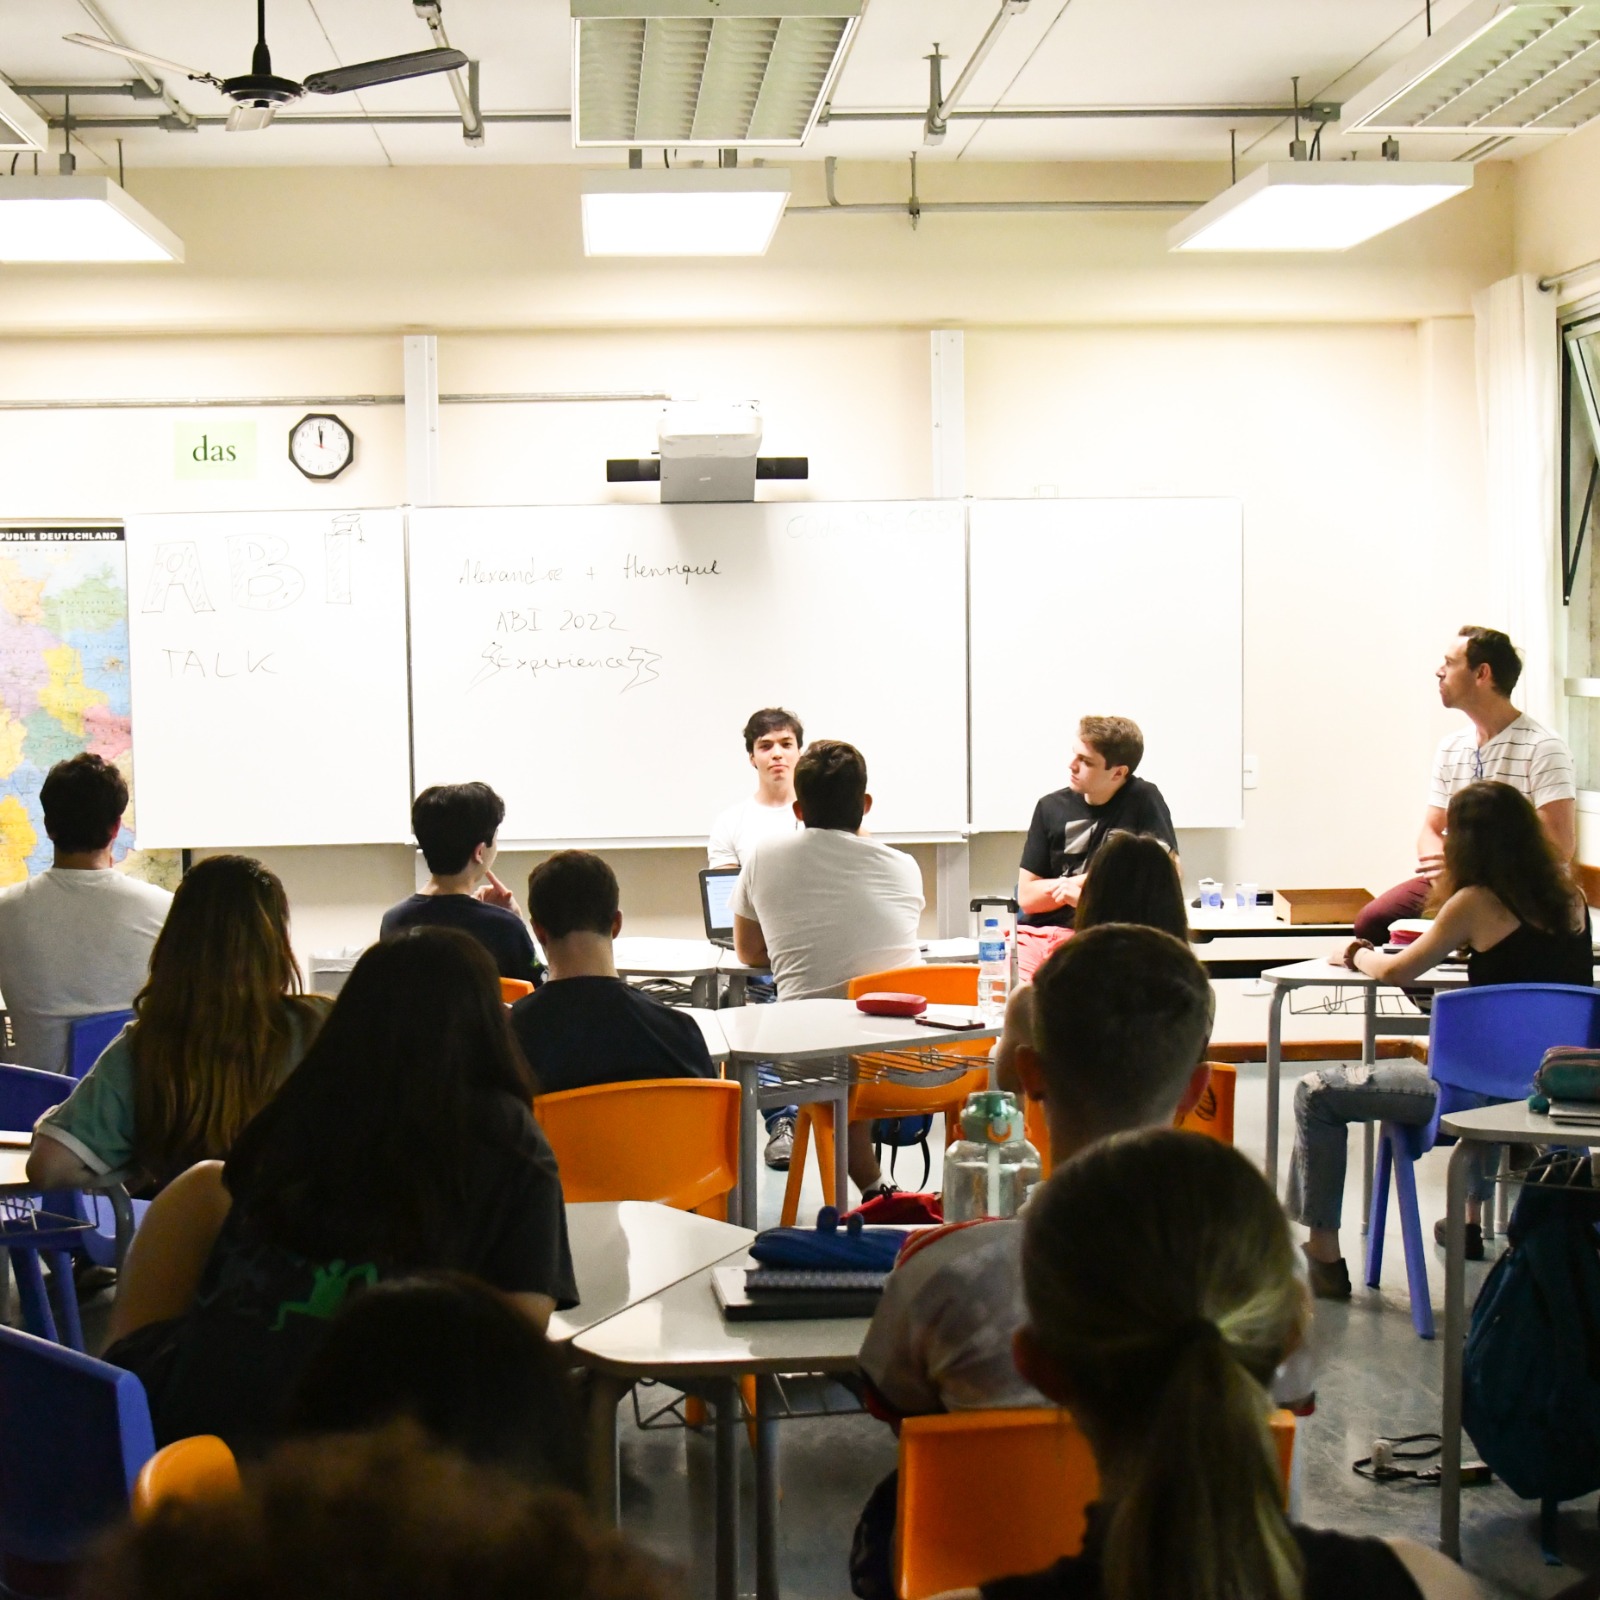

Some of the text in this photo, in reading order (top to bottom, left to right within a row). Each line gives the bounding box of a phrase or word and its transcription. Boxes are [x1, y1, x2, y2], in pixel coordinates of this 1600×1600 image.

[193, 434, 236, 462] das
[40, 531, 118, 541] DEUTSCHLAND
[623, 553, 720, 585] Henrique
[496, 607, 629, 632] ABI 2022
[161, 648, 279, 678] TALK
[496, 655, 625, 678] Experience
